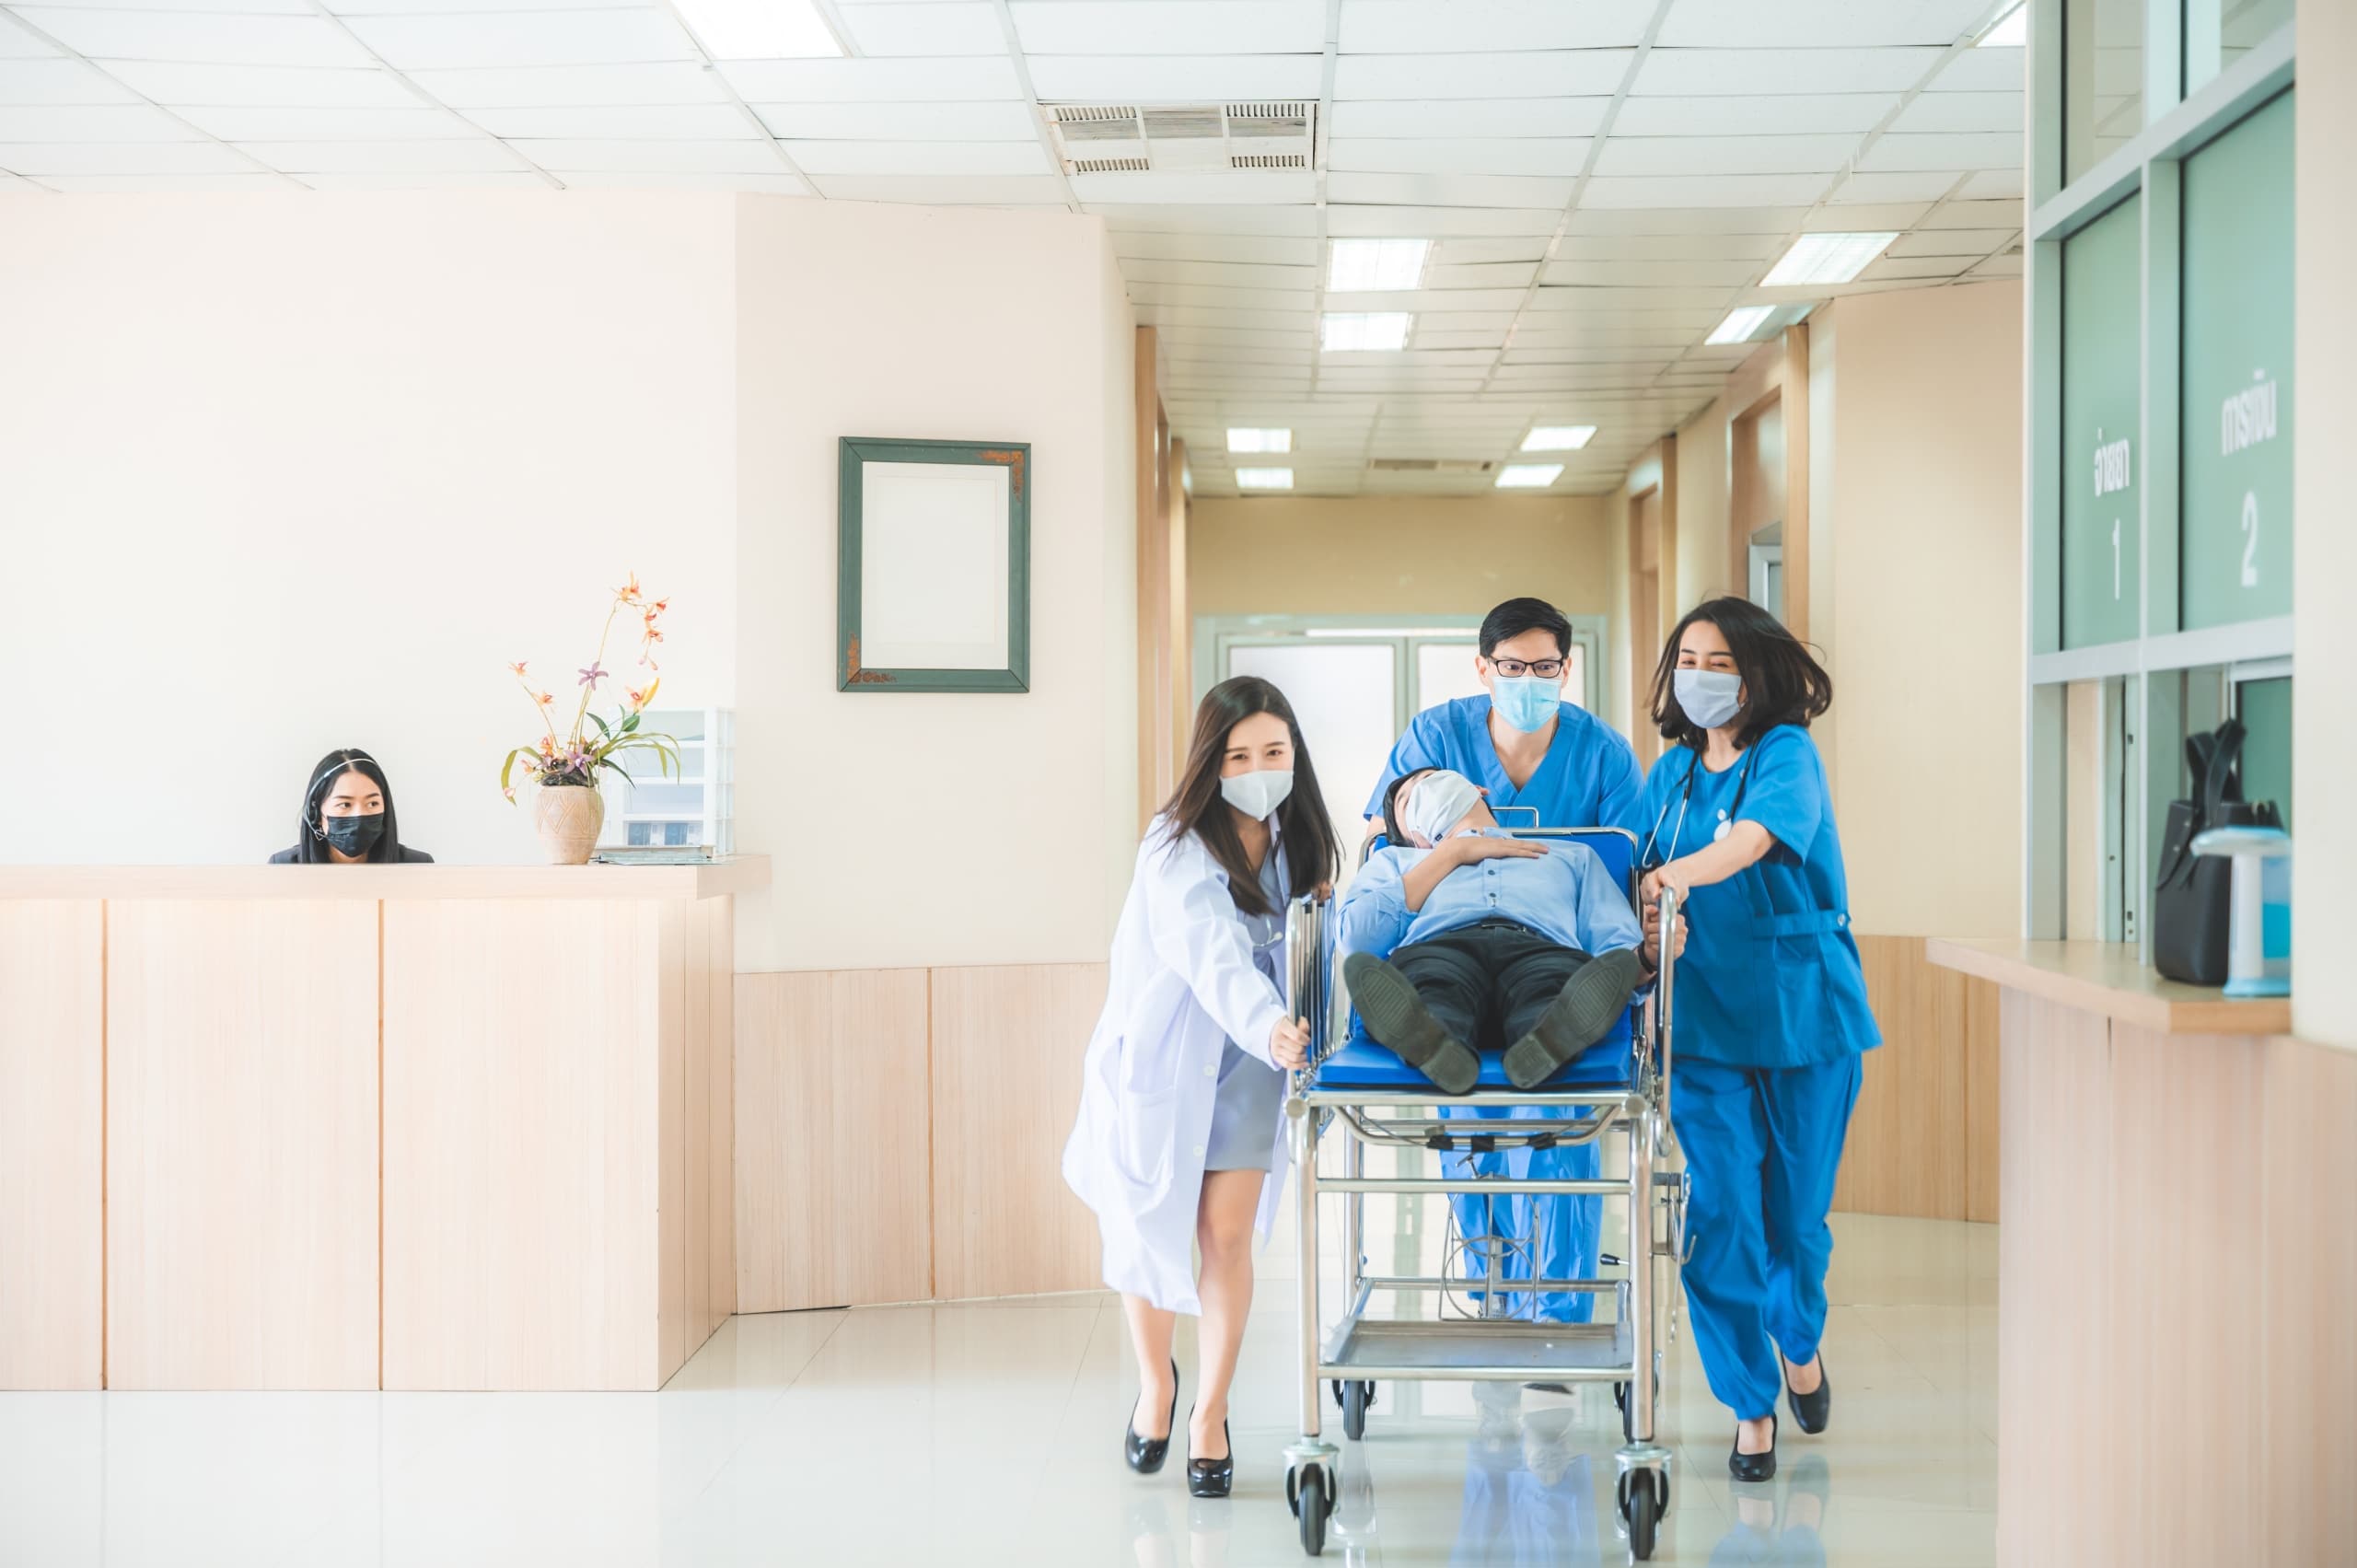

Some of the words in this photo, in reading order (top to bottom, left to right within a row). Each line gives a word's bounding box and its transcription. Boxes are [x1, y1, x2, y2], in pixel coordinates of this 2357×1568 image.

[2222, 368, 2277, 457] การเงิน
[2094, 426, 2130, 497] จ่ายยา
[2112, 518, 2120, 600] 1
[2241, 490, 2258, 588] 2
